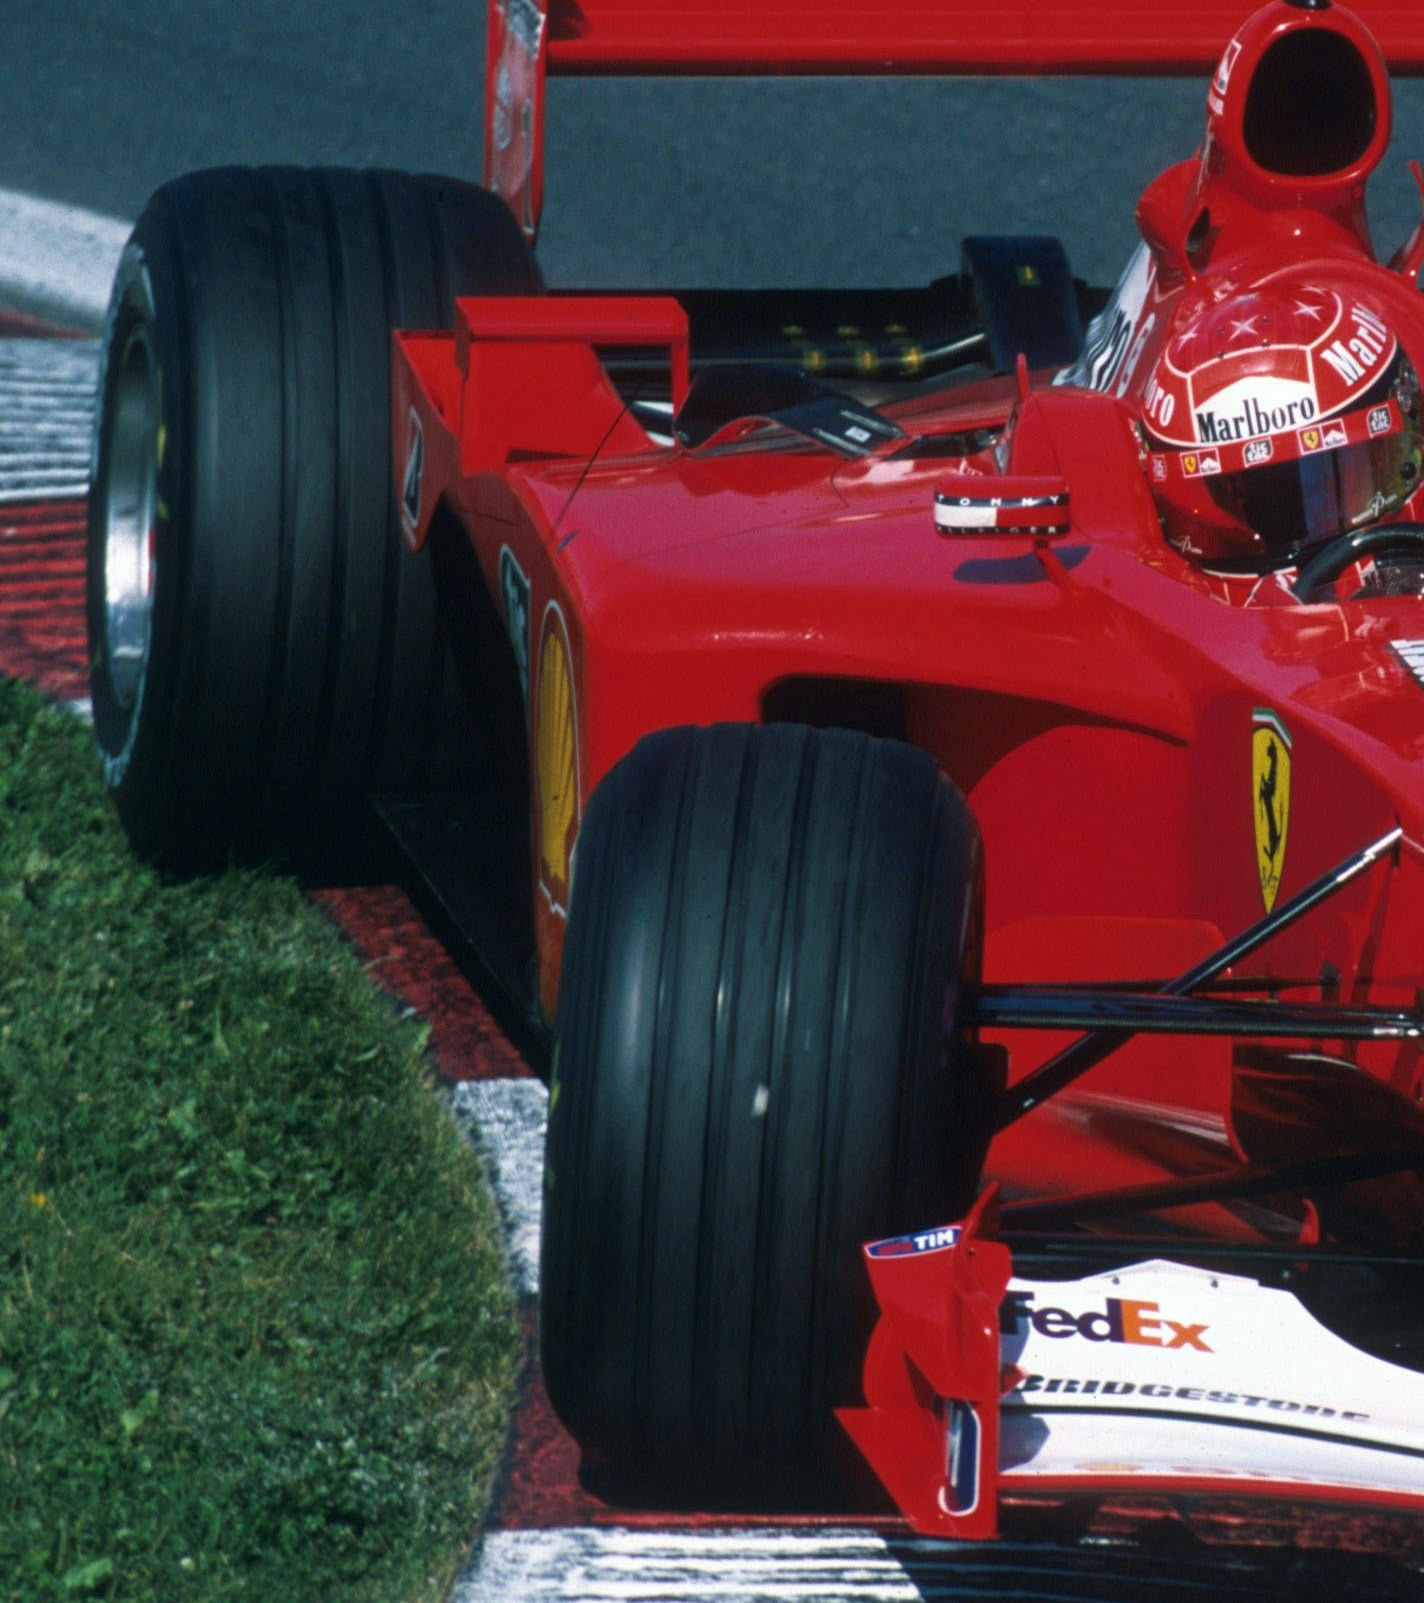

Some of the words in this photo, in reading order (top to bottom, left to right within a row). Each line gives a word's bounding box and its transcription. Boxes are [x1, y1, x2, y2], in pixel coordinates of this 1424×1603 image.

[1196, 397, 1315, 443] Marlboro
[938, 494, 1059, 507] TOMMY
[914, 1229, 954, 1250] TIM
[998, 1290, 1215, 1353] FedEx
[1013, 1374, 1370, 1421] BRIDGESTONE
